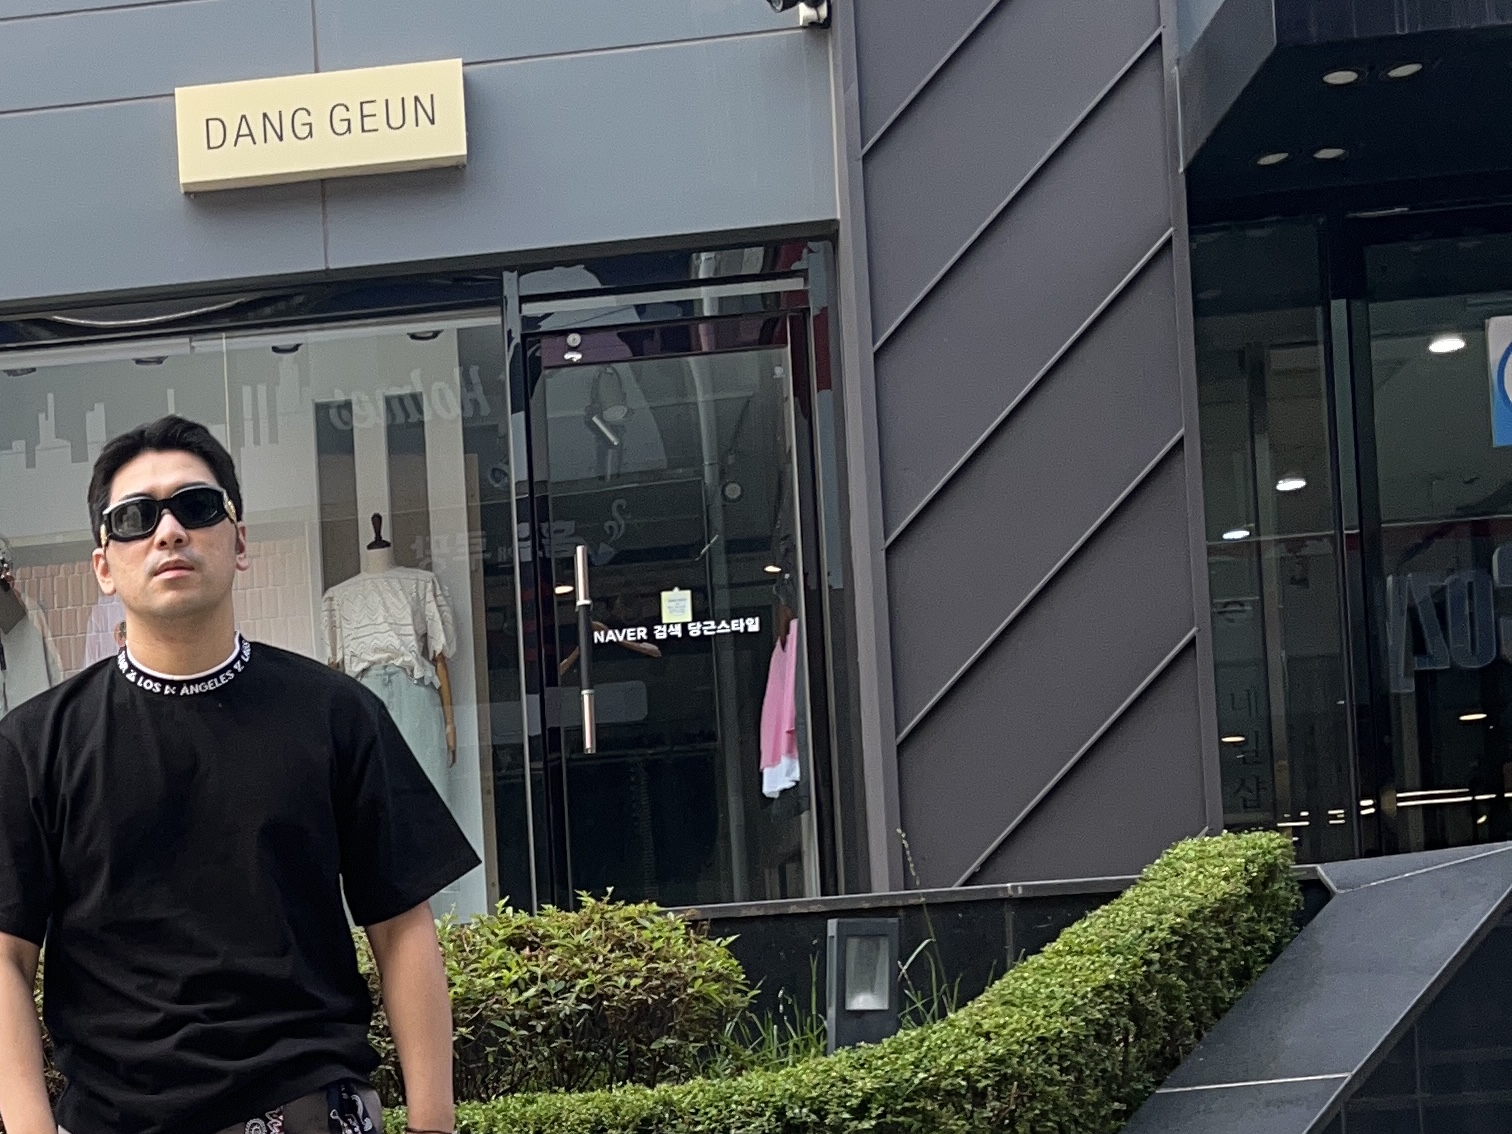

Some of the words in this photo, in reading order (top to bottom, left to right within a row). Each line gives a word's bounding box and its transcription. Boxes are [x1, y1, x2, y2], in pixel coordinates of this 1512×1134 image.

[204, 106, 314, 150] DANG
[329, 93, 437, 136] GEUN
[593, 627, 648, 644] NAVER
[653, 623, 683, 640] 검색
[687, 616, 760, 638] 당근스타일
[136, 676, 162, 694] LOS
